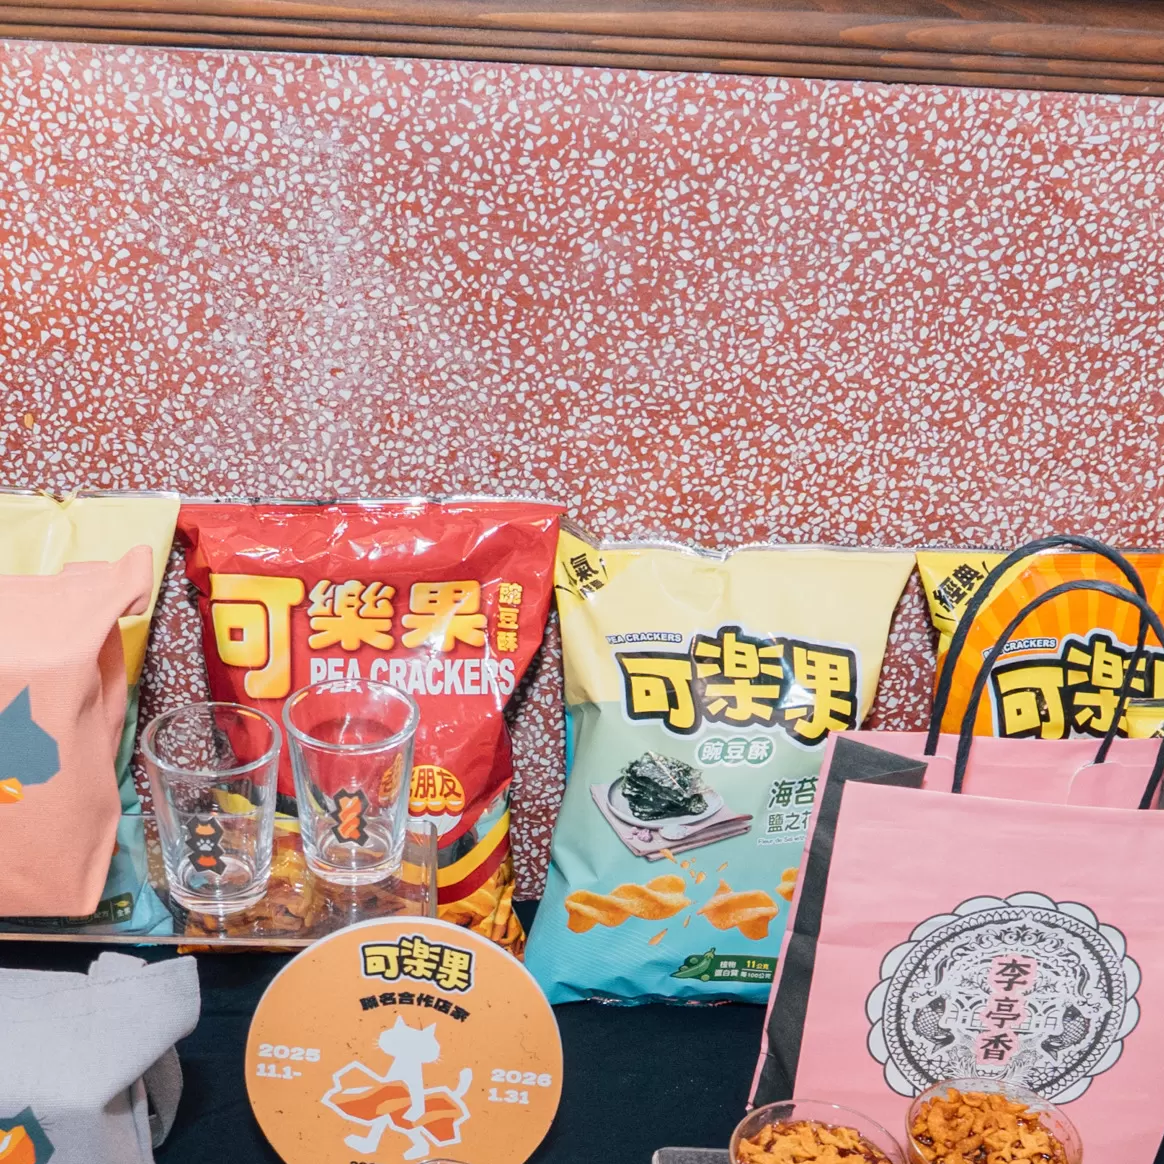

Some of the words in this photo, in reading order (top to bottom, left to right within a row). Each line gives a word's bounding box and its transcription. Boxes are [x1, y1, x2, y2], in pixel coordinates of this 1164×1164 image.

[211, 573, 488, 699] 可樂果
[625, 632, 682, 643] CRACKERS
[1004, 638, 1056, 652] CRACKERS
[310, 657, 363, 694] PEA
[368, 657, 516, 696] CRACKERS
[409, 767, 462, 799] 朋友
[979, 957, 1032, 1062] 李亭香
[258, 1043, 322, 1063] 2025
[490, 1067, 553, 1088] 2026
[487, 1087, 530, 1106] 1.31
